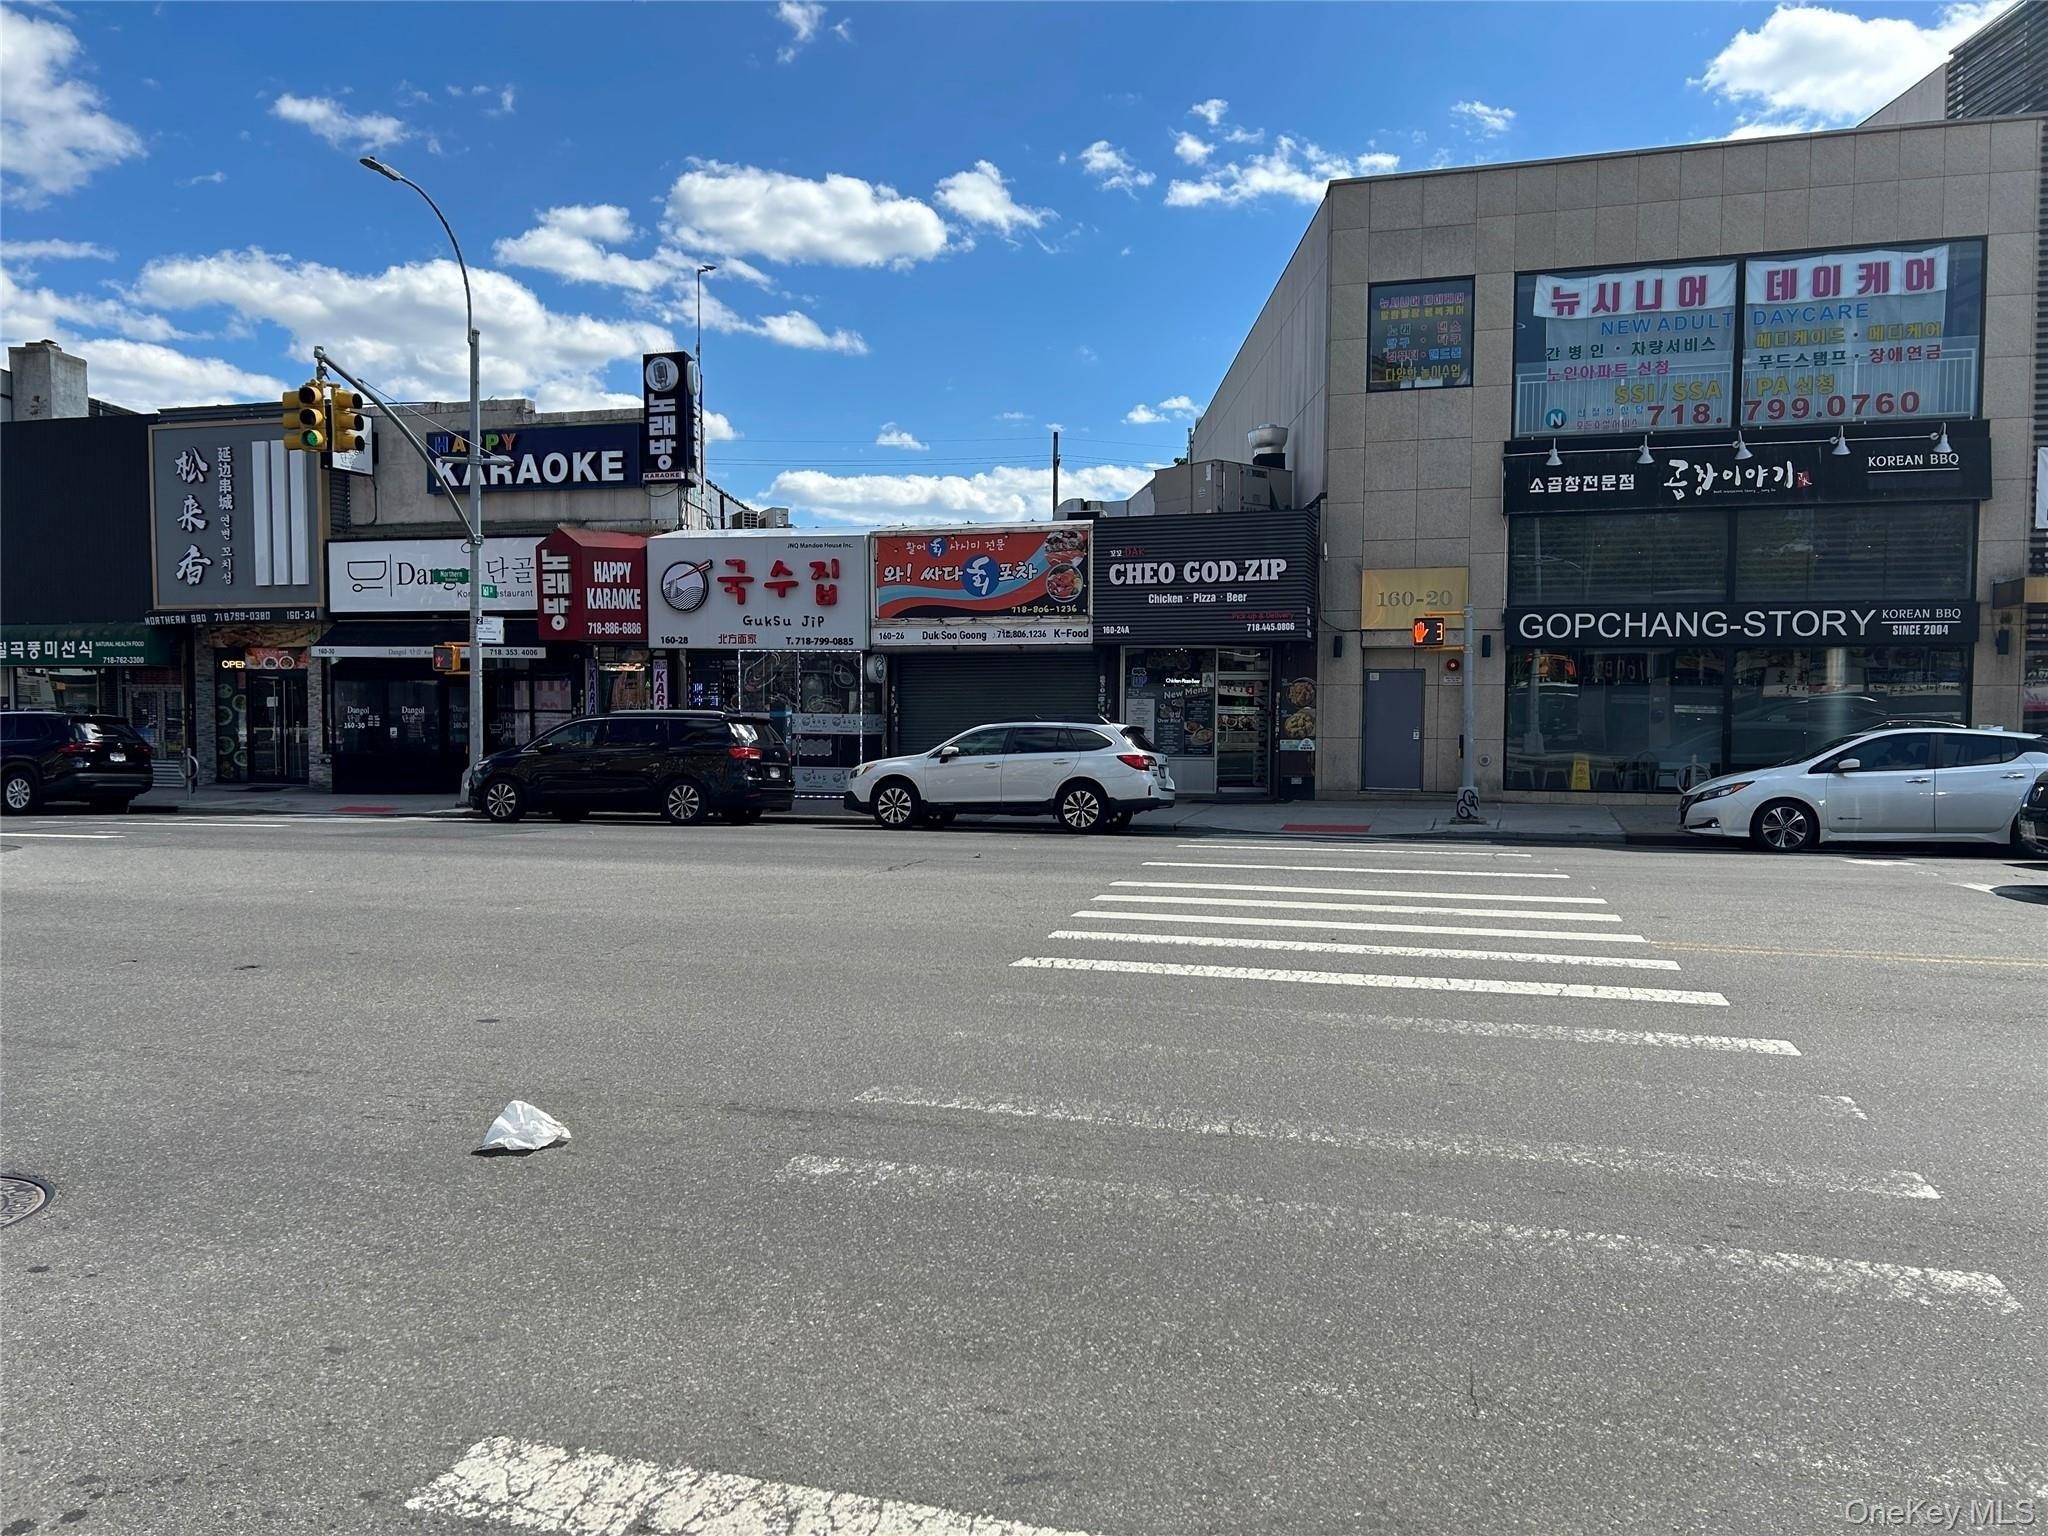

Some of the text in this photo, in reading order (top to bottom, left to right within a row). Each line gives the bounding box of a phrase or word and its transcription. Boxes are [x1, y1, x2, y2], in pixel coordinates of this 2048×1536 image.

[1551, 258, 1935, 316] 뉴시니어 데이케어
[1601, 303, 1869, 335] NEW ADULT DAYCARE
[1756, 321, 1942, 349] 메디케이드 메디케어
[1631, 337, 1716, 356] 차량서비스
[1758, 345, 1941, 370] 푸드스탬프 장애연금
[1547, 360, 1669, 382] 노인아파트 신청
[1794, 374, 1835, 397] 신청
[434, 432, 517, 453] HAPY
[649, 393, 676, 471] 노래방
[435, 451, 624, 487] KARAOKE
[1868, 453, 1960, 467] KOREAN BBQ
[1529, 474, 1635, 493] 소곱창전문점
[1663, 459, 1794, 501] 곱창이야기
[906, 541, 926, 554] 활어
[985, 538, 1006, 551] 전문
[485, 556, 535, 584] 단골
[593, 561, 632, 583] HAPPY
[883, 562, 912, 583] 와!
[998, 561, 1038, 581] 포차
[1109, 558, 1287, 585] CHEO GOD.ZIP
[541, 549, 570, 631] 노래방
[717, 558, 840, 606] 국수집
[586, 588, 641, 610] KARAOKE
[1148, 591, 1247, 604] Chicken Pizza Beer
[1376, 590, 1453, 607] 160-20
[286, 610, 315, 620] 160-34
[1519, 609, 1877, 639] GOPCHANG-STORY
[1881, 608, 1961, 619] KOREAN BBQ
[587, 622, 641, 634] 718-886-6886
[879, 631, 904, 640] 160-26
[922, 630, 939, 640] Duk
[941, 630, 957, 640] Soo
[959, 630, 987, 641] Goong
[1053, 628, 1089, 638] K-Food
[1436, 622, 1443, 641] 3
[1892, 624, 1949, 635] SINCE 2004
[660, 636, 688, 645] 160-28
[1163, 690, 1183, 700] New
[1184, 687, 1208, 696] Menu
[347, 706, 370, 715] Dangol
[401, 706, 425, 715] Dangol
